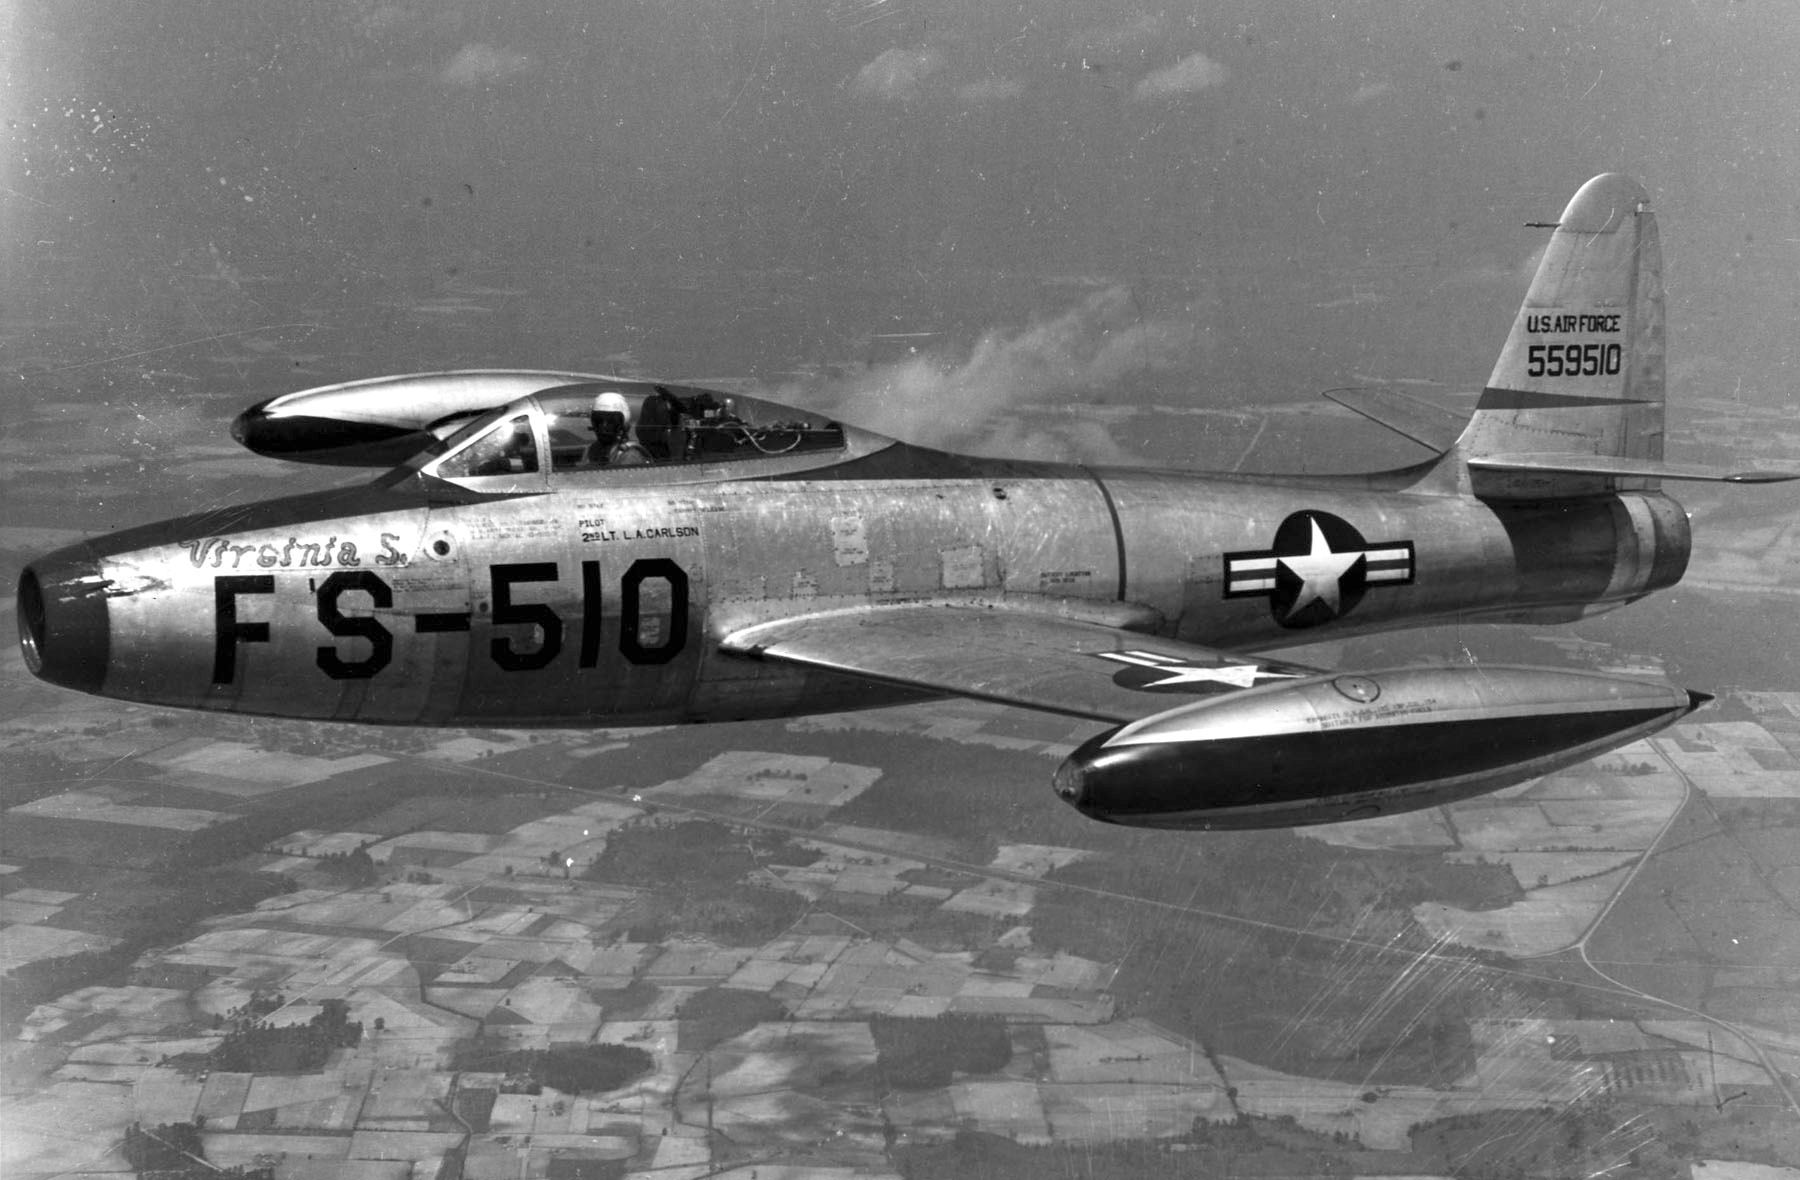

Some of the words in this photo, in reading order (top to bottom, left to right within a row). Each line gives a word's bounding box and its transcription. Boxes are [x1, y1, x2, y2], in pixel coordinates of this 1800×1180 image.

[1579, 315, 1621, 333] FORCE
[1528, 343, 1622, 377] 559510
[579, 519, 605, 528] PILOT
[178, 536, 361, 568] Virginia
